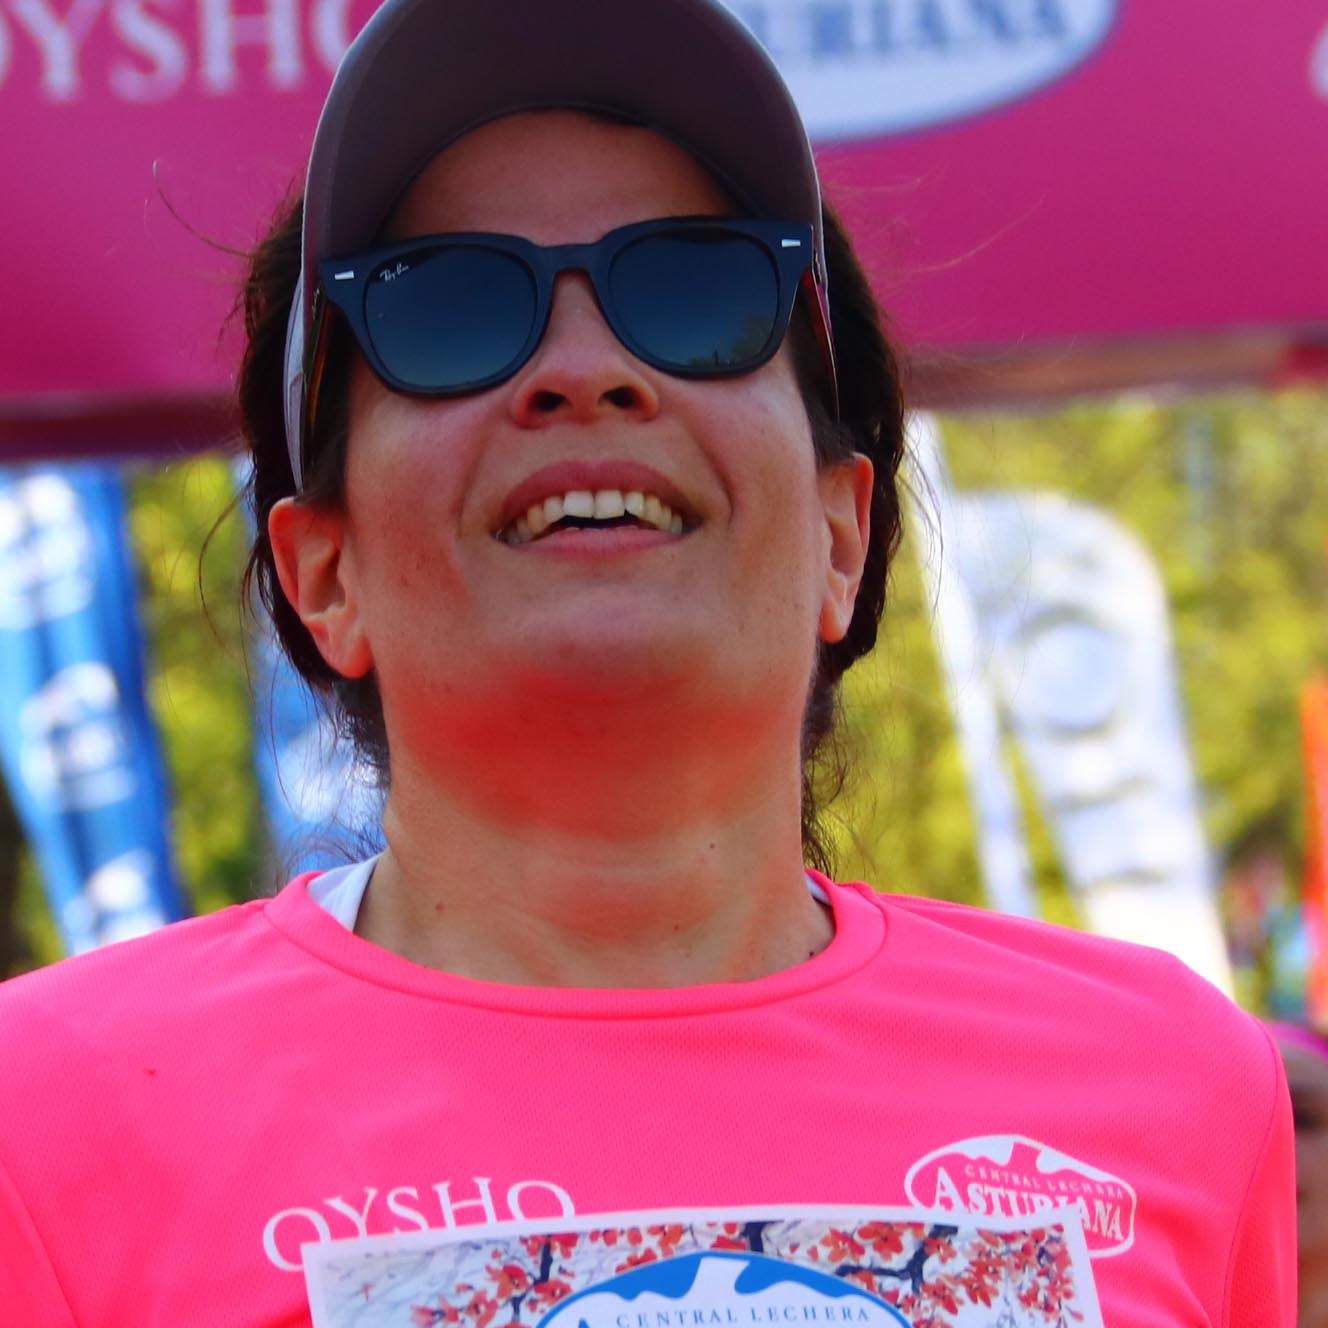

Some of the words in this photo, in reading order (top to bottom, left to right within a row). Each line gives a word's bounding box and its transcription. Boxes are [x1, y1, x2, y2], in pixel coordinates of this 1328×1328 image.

[262, 1176, 576, 1272] OYSHO
[615, 1307, 738, 1328] CENTRAL
[750, 1305, 870, 1323] LECHERA
